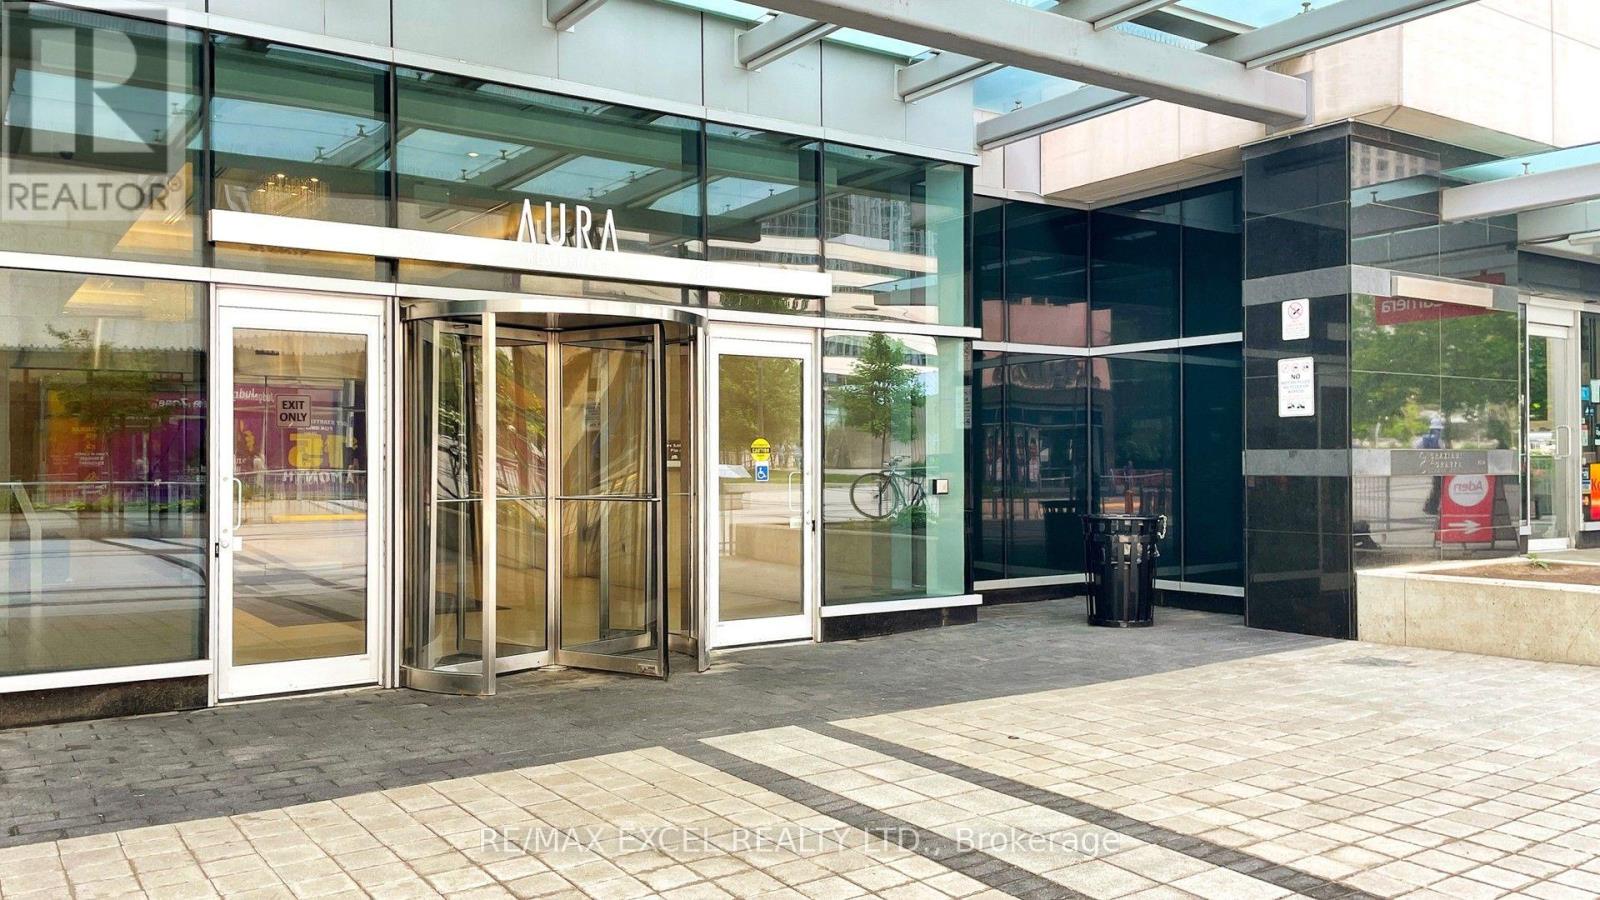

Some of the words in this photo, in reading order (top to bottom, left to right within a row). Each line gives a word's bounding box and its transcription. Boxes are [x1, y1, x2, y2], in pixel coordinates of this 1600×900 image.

[517, 198, 619, 252] AURA
[282, 400, 304, 411] EXIT
[279, 412, 308, 423] ONLY
